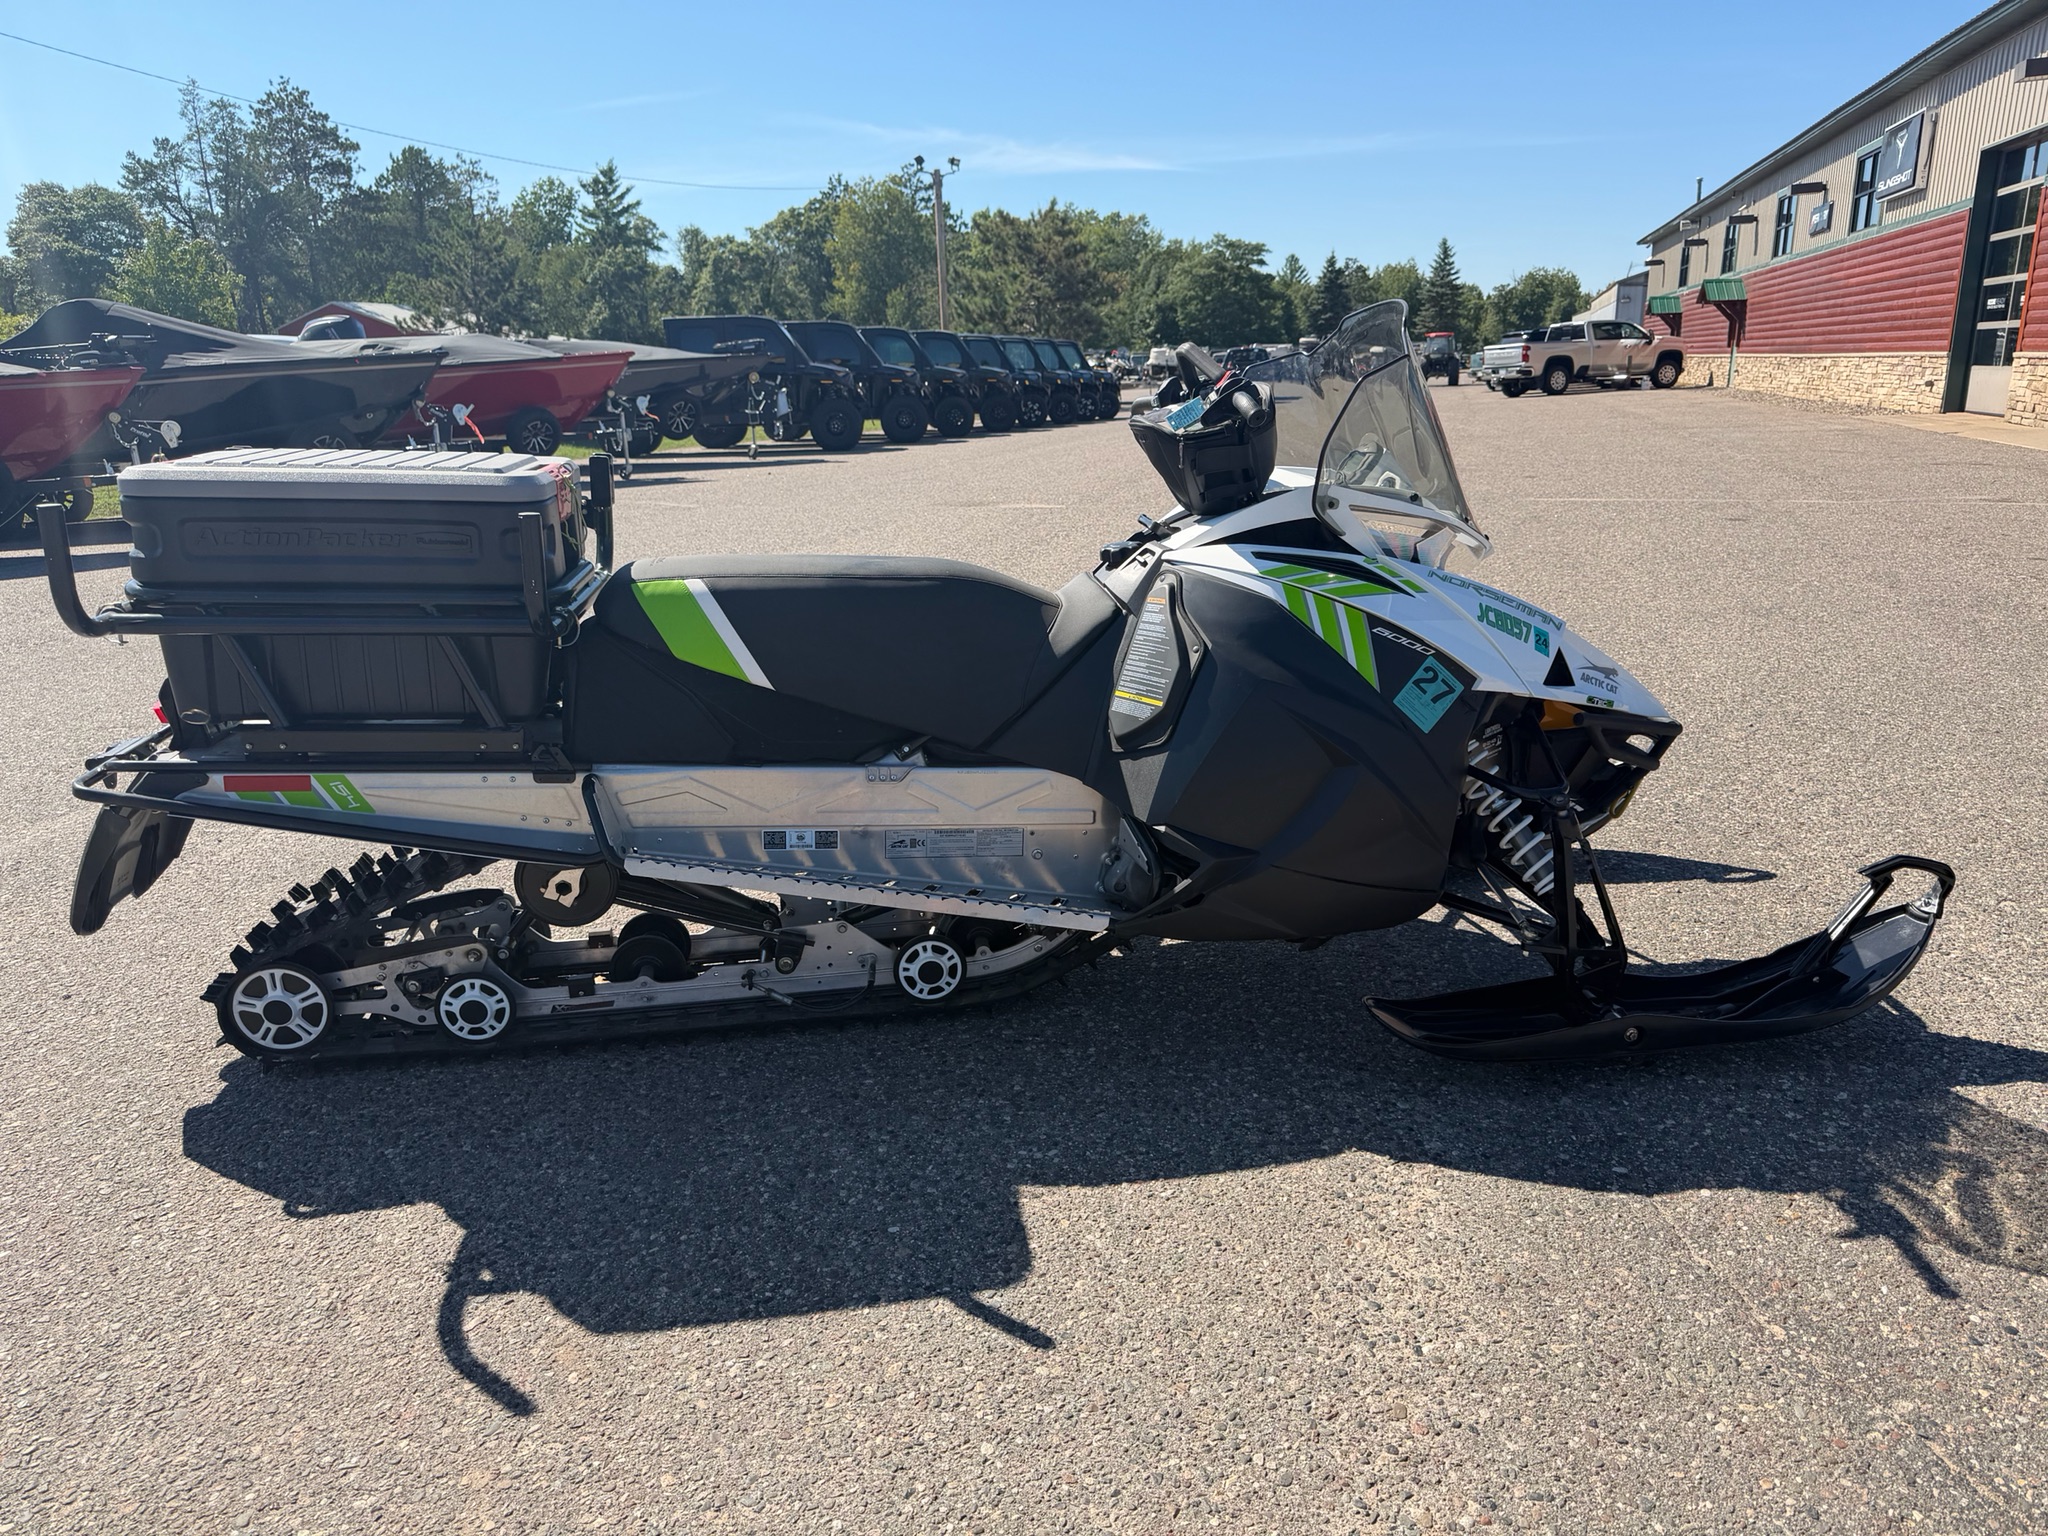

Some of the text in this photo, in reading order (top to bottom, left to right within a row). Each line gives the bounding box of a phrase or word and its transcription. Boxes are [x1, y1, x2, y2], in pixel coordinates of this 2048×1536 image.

[1877, 168, 1913, 192] SLINGSHOT
[197, 527, 408, 548] ActionPacker
[1427, 569, 1563, 631] NORSEMAN
[1535, 633, 1549, 648] 24
[1412, 665, 1457, 705] 27
[1580, 672, 1618, 695] ARCTIC CAT
